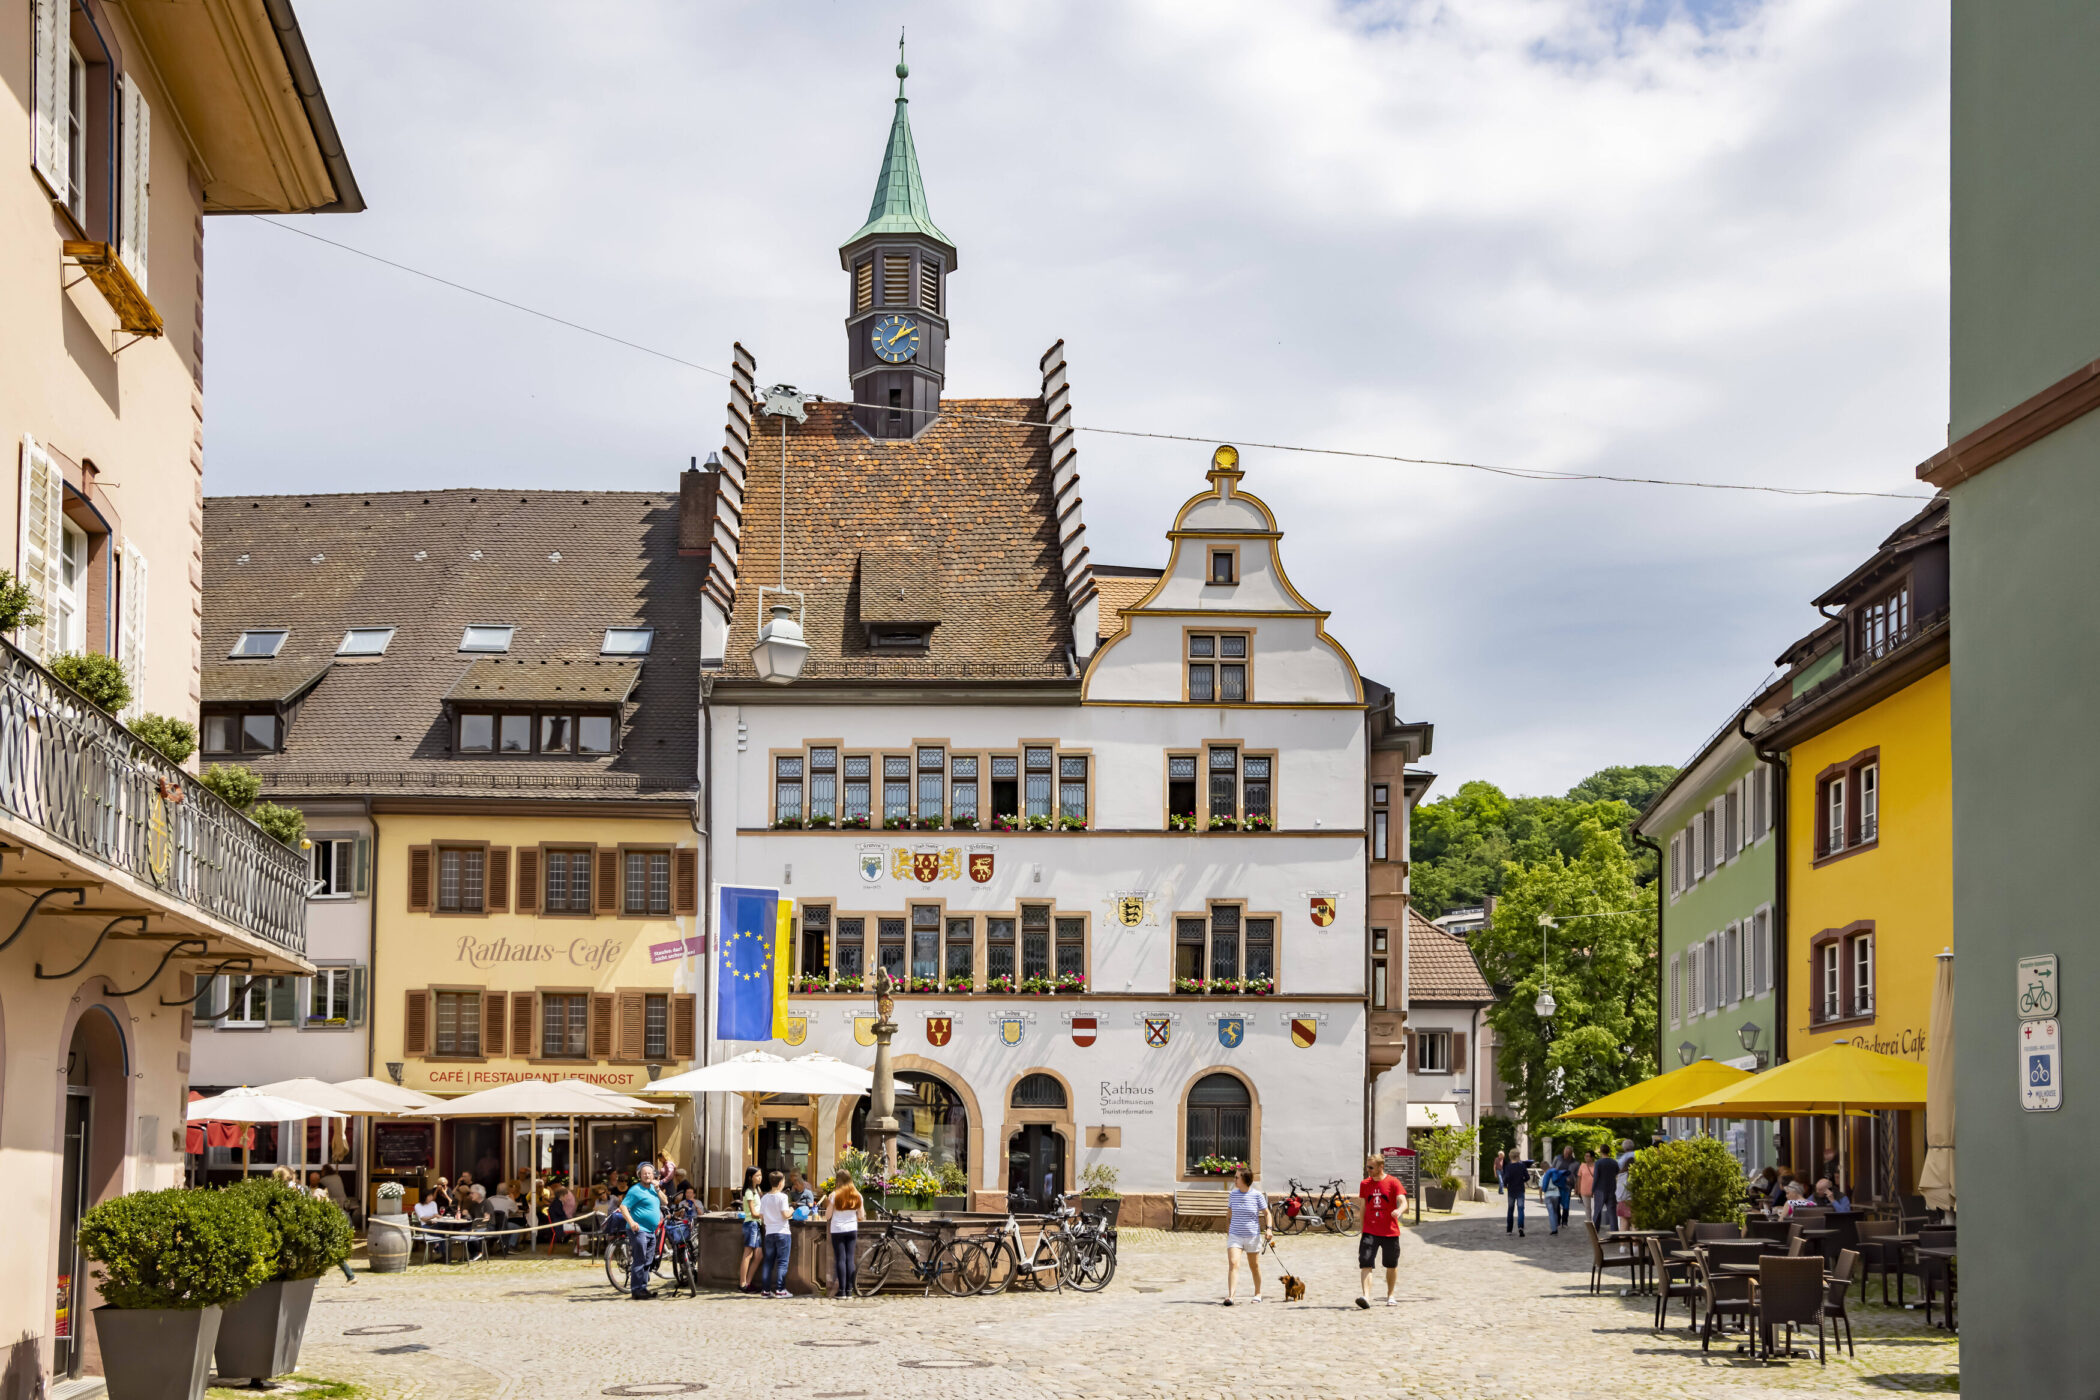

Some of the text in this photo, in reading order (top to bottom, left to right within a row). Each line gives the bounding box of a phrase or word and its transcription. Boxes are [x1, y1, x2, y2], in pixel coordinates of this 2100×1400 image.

[456, 936, 622, 970] Rathaus-Café
[1902, 1028, 1926, 1061] Café
[429, 1069, 464, 1083] CAFÉ
[1100, 1081, 1154, 1096] Rathaus
[1100, 1096, 1154, 1106] Stadtmuseum
